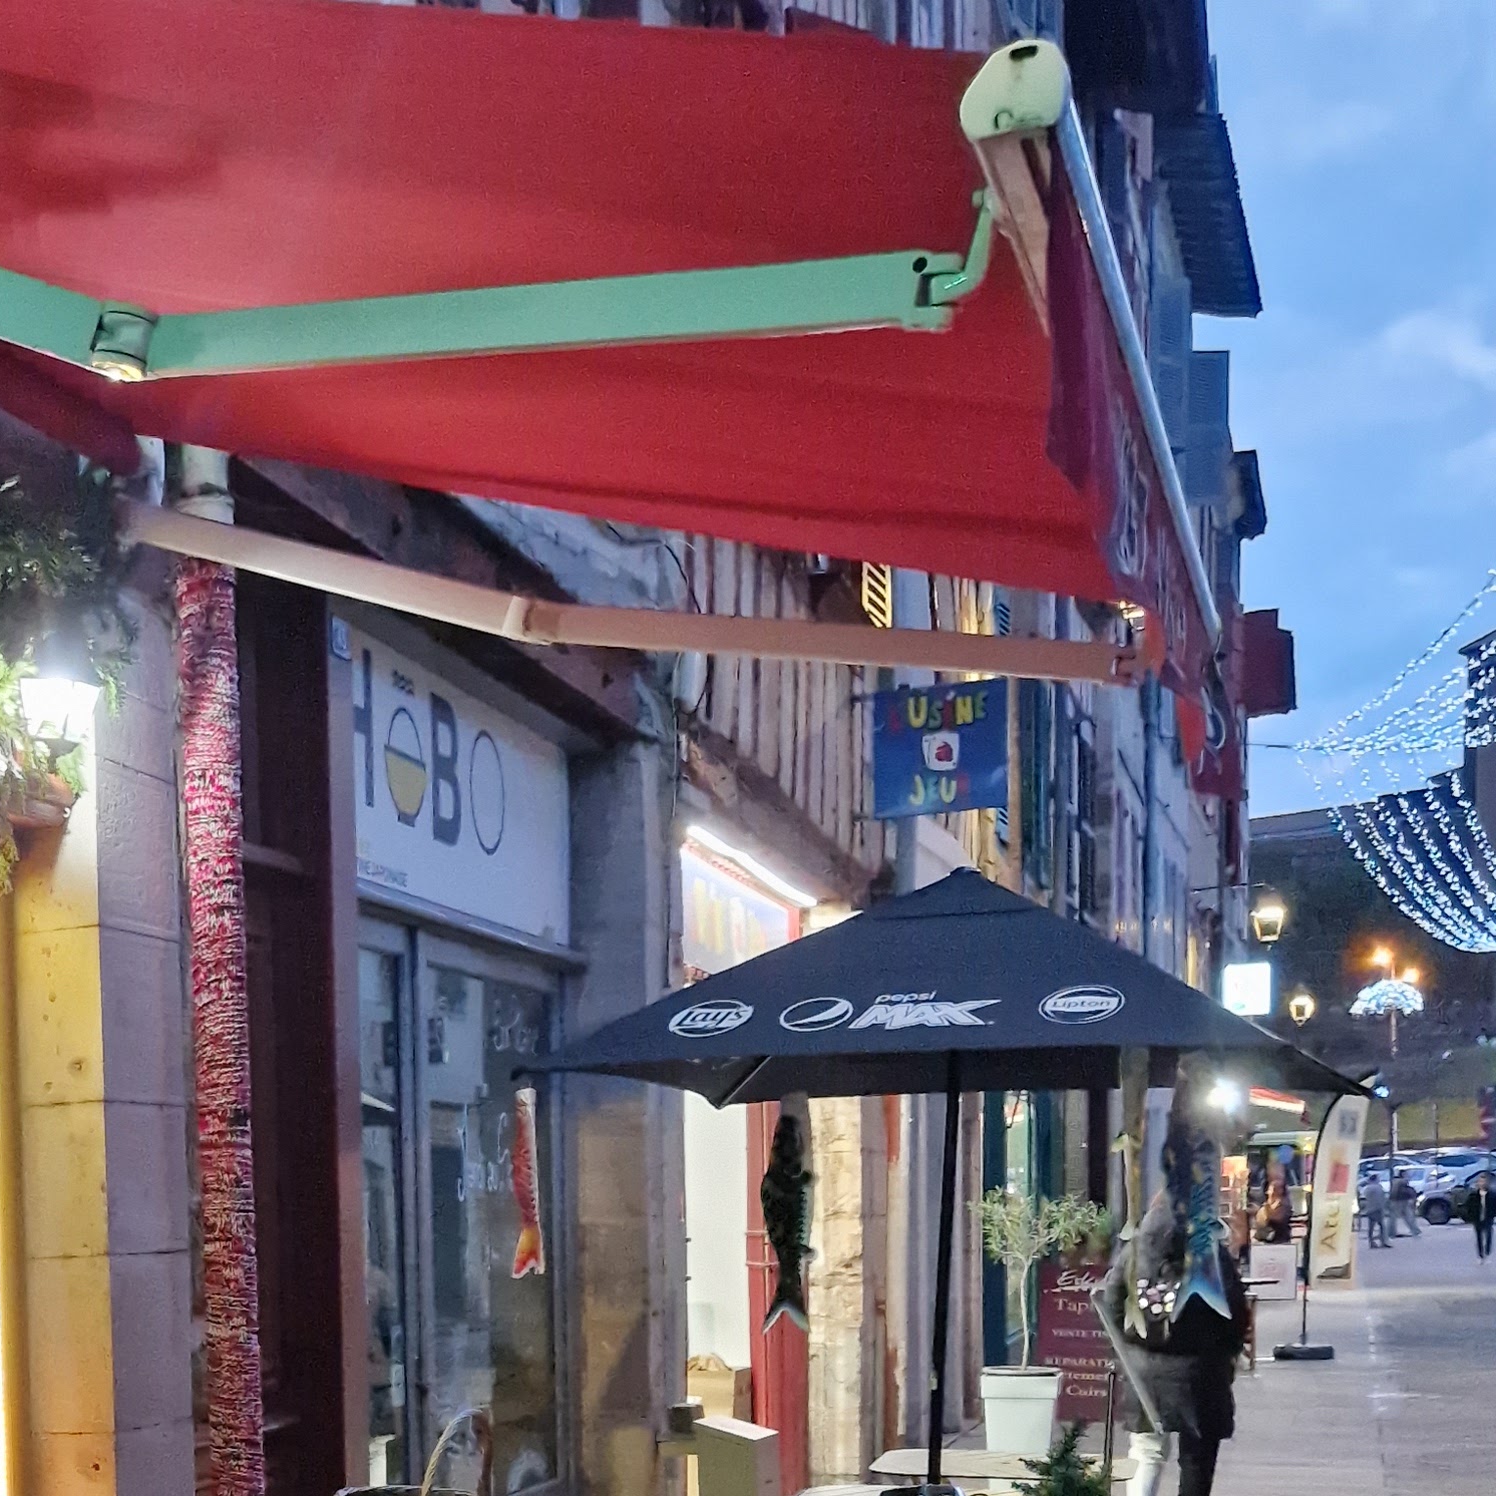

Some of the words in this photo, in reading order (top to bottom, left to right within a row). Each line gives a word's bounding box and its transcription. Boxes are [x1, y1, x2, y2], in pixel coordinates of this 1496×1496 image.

[875, 990, 937, 1004] pepsi
[1053, 998, 1112, 1011] Lipton
[849, 999, 1002, 1030] MAX
